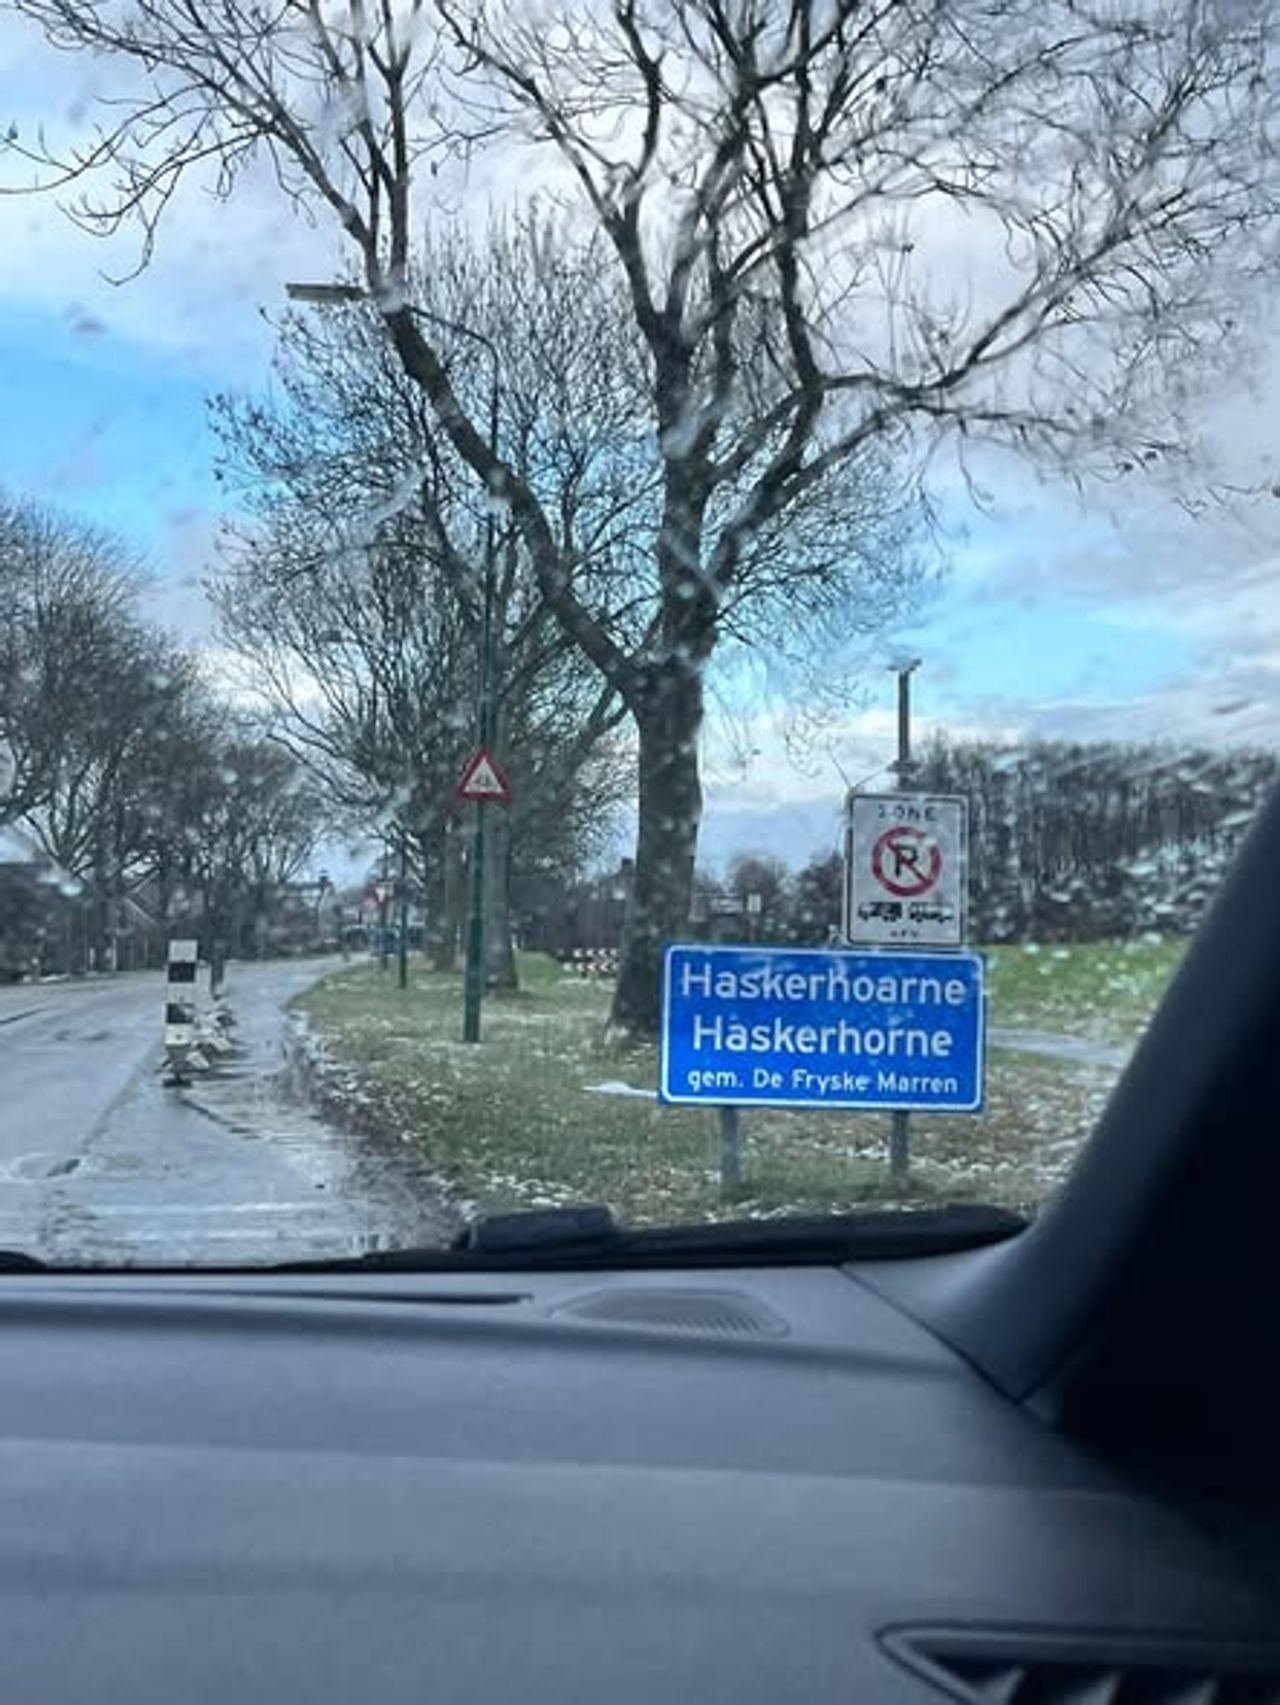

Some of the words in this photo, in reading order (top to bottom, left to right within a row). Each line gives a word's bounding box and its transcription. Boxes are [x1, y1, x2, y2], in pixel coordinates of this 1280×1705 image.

[681, 961, 967, 1005] Haskerhoarne
[692, 1014, 954, 1056] Haskerhorne
[687, 1068, 744, 1092] gem.
[753, 1068, 782, 1088] De
[791, 1069, 870, 1094] Fryske
[877, 1072, 958, 1093] Marren
